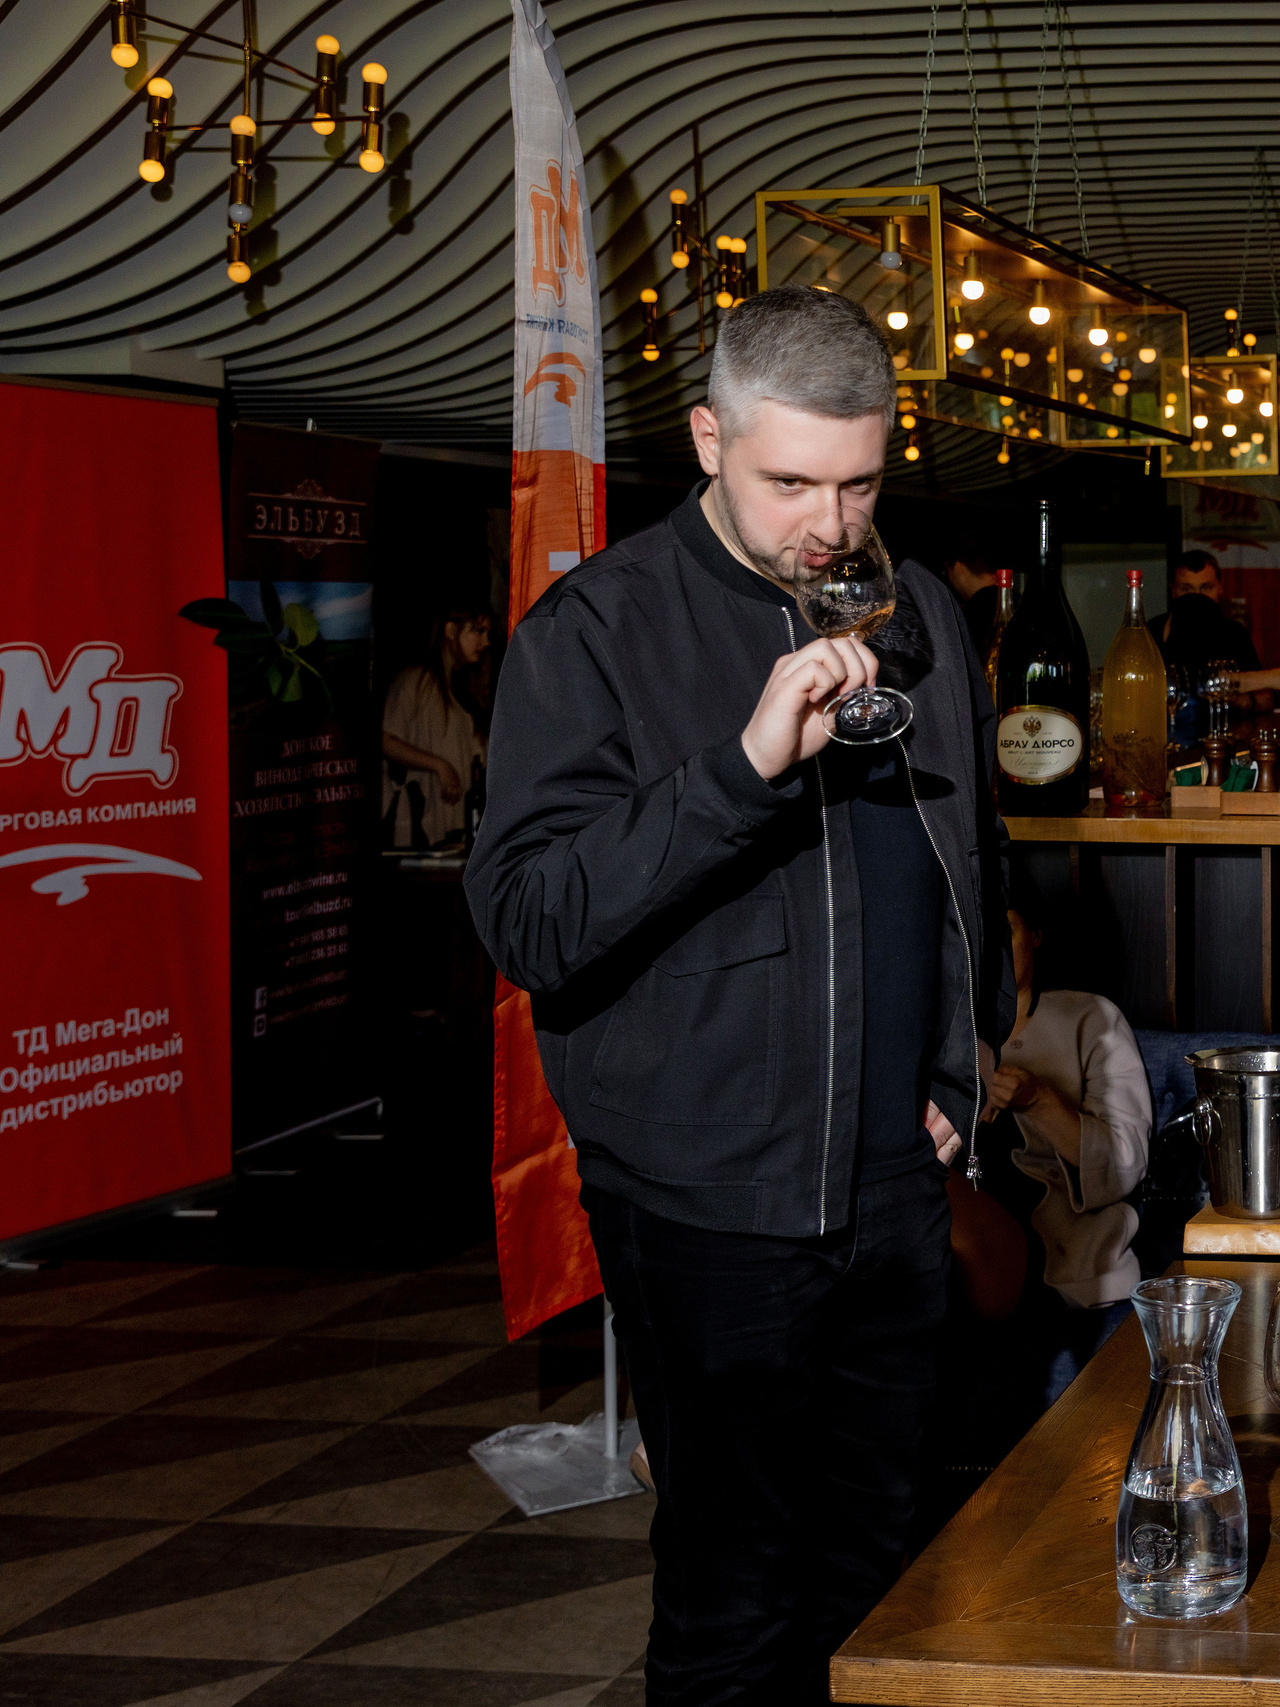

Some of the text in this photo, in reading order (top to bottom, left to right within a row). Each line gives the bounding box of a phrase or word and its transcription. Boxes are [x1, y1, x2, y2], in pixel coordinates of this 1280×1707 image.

[254, 503, 361, 538] ЭЛЬБУЗД
[281, 734, 335, 760] ДОНКОЕ
[1000, 738, 1075, 749] АБРАУ ДЮРСО
[86, 797, 197, 824] КОМПАНИЯ
[12, 1007, 170, 1058] ТД Мега-Дон
[0, 1031, 183, 1094] Официальный
[0, 1069, 184, 1134] дистрибьютор
